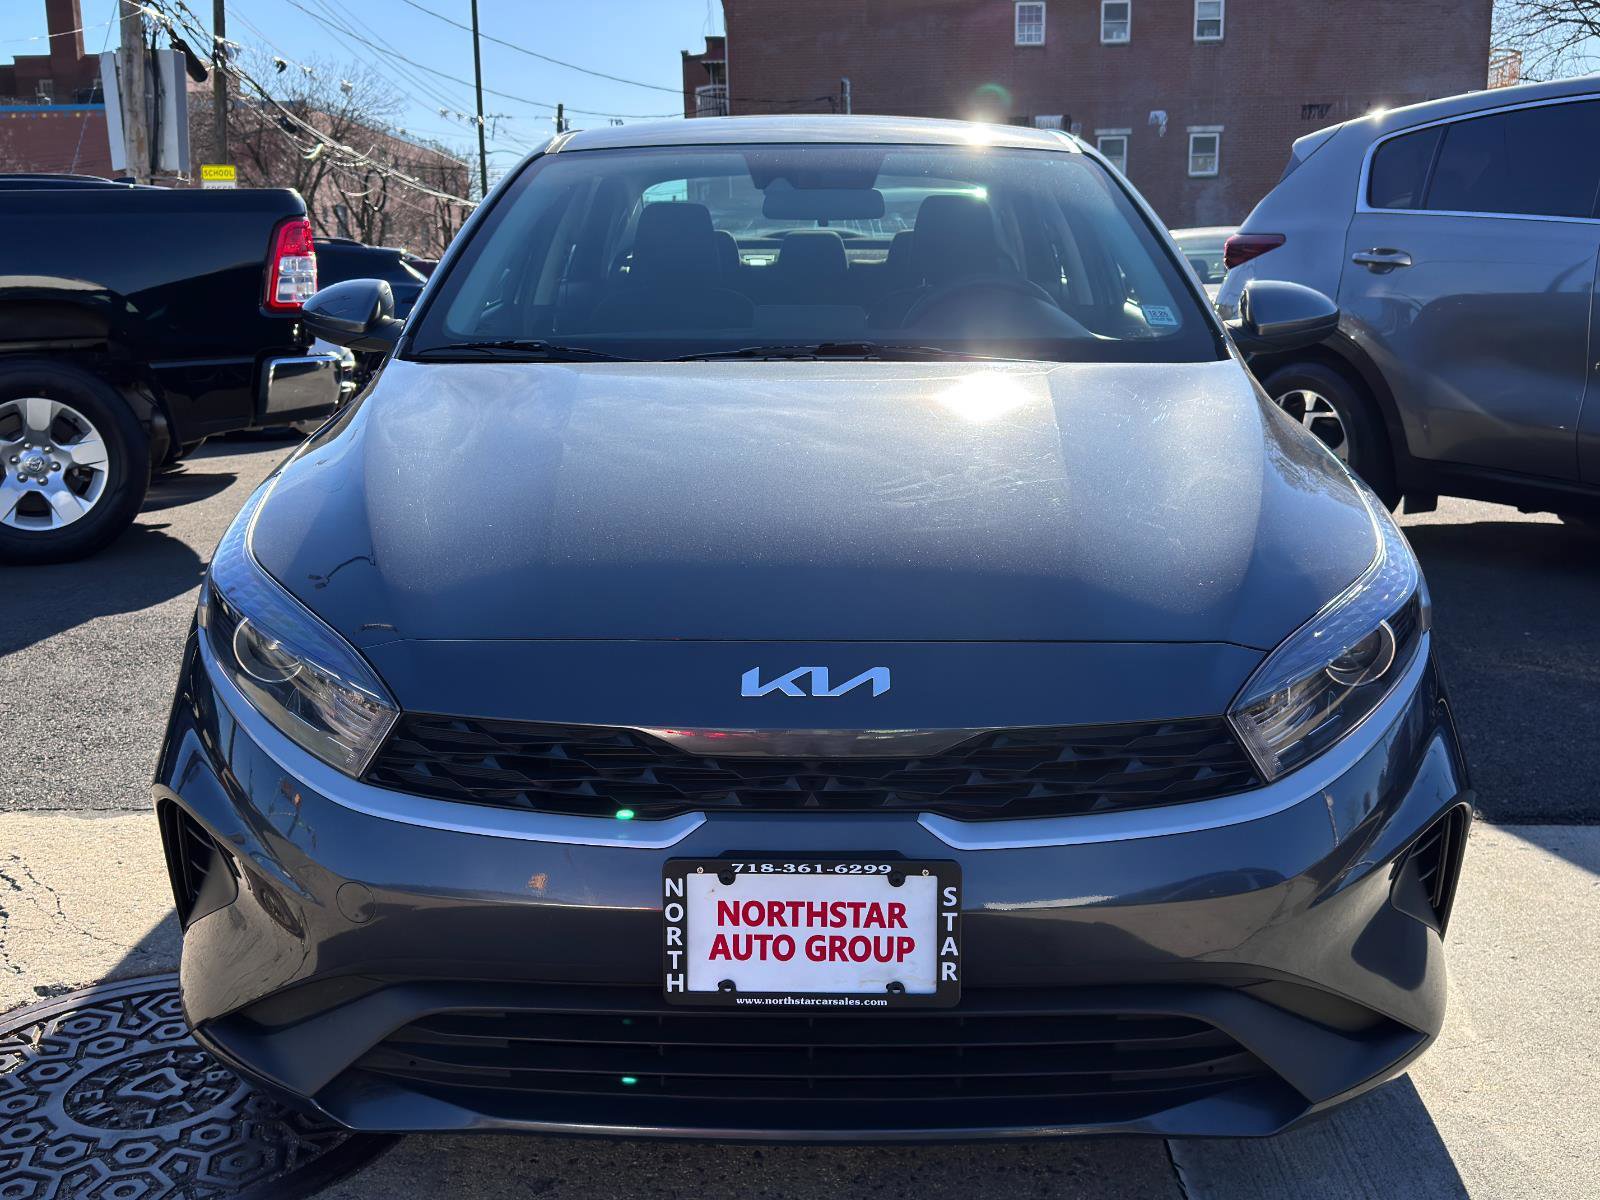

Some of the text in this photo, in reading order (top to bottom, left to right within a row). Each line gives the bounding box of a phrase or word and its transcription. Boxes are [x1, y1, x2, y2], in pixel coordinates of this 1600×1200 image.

[203, 168, 234, 177] SCHOOL
[731, 863, 892, 875] 718-361-6299
[716, 899, 909, 929] NORTHSTAR
[664, 877, 685, 993] NORTH
[708, 933, 916, 963] AUTO GROUP
[939, 886, 960, 982] STAR
[736, 996, 888, 1007] www.northstarcarsales.com
